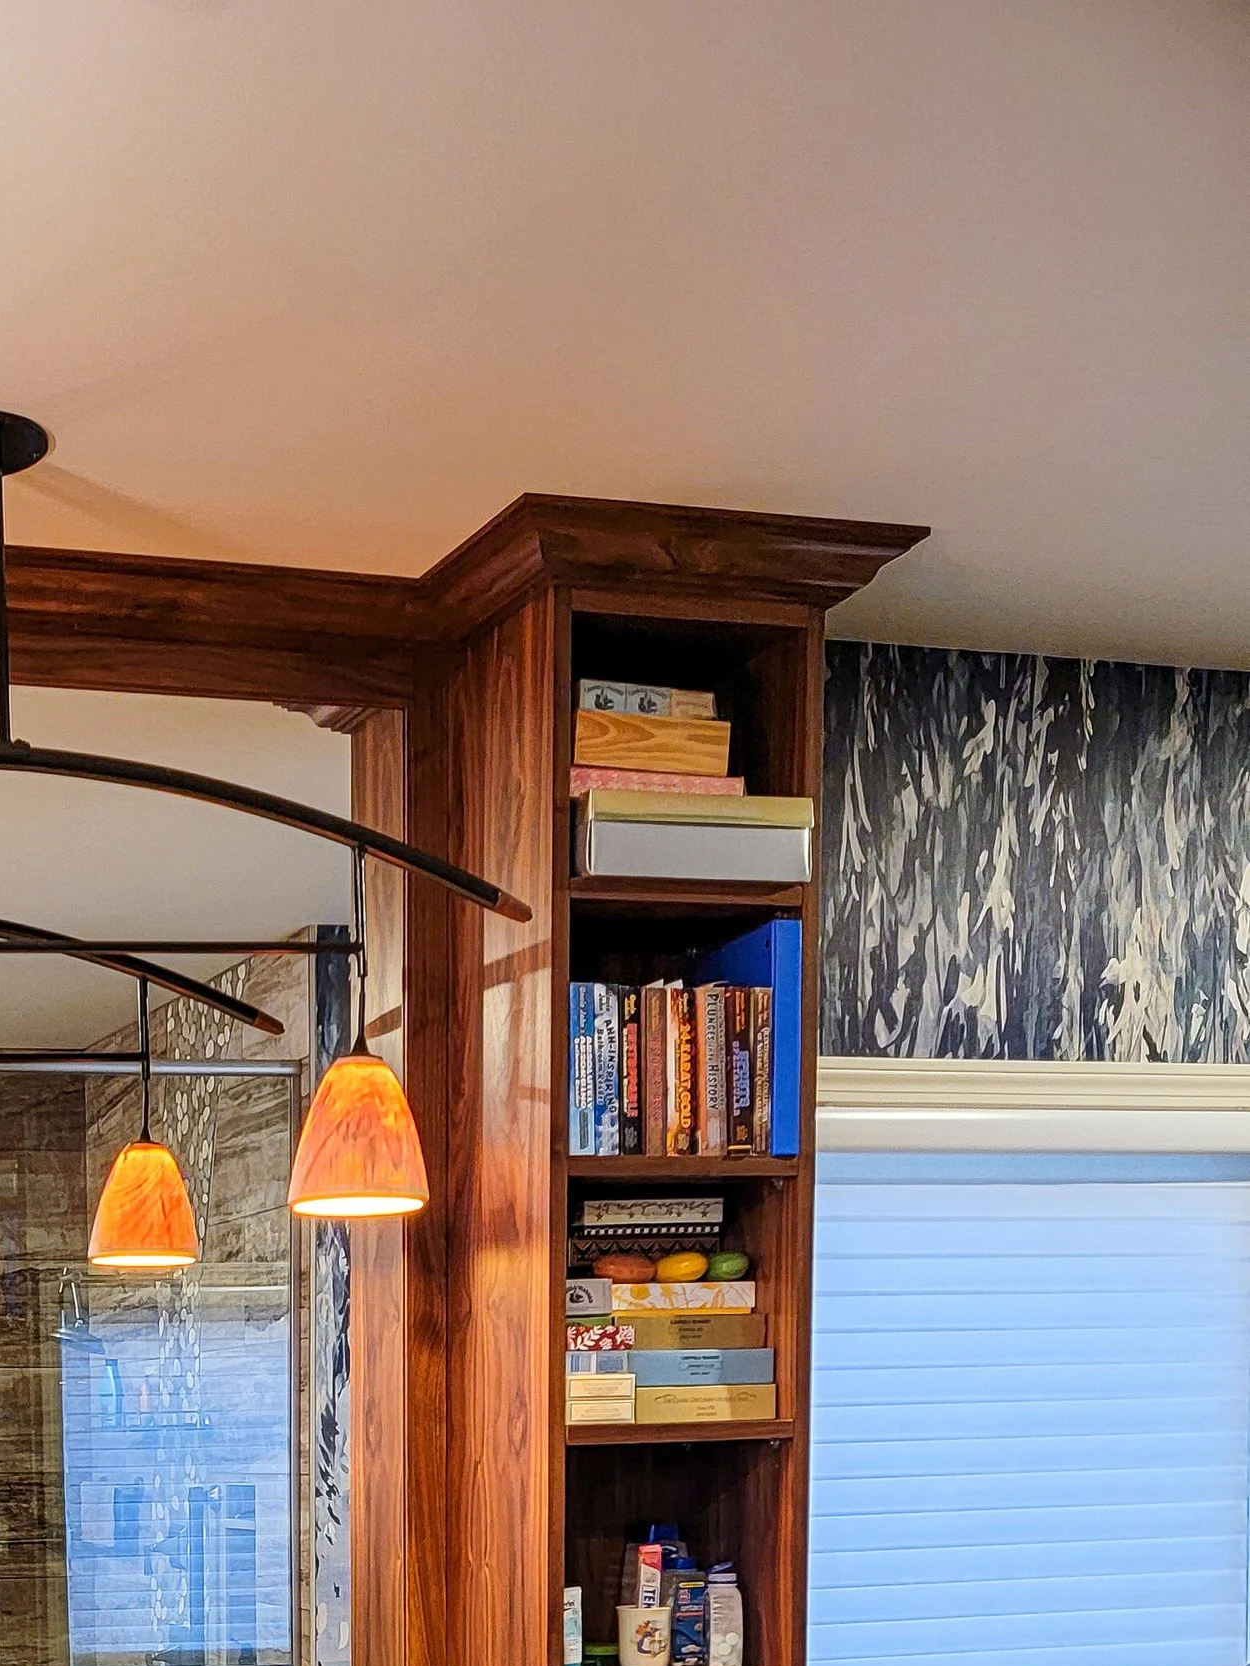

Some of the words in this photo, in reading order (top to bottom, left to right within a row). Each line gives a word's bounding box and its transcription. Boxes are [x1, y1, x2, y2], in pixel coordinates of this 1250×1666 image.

[707, 993, 719, 1041] PLUNGES
[597, 1028, 605, 1072] Bathroom
[707, 1064, 719, 1110] HISTORY
